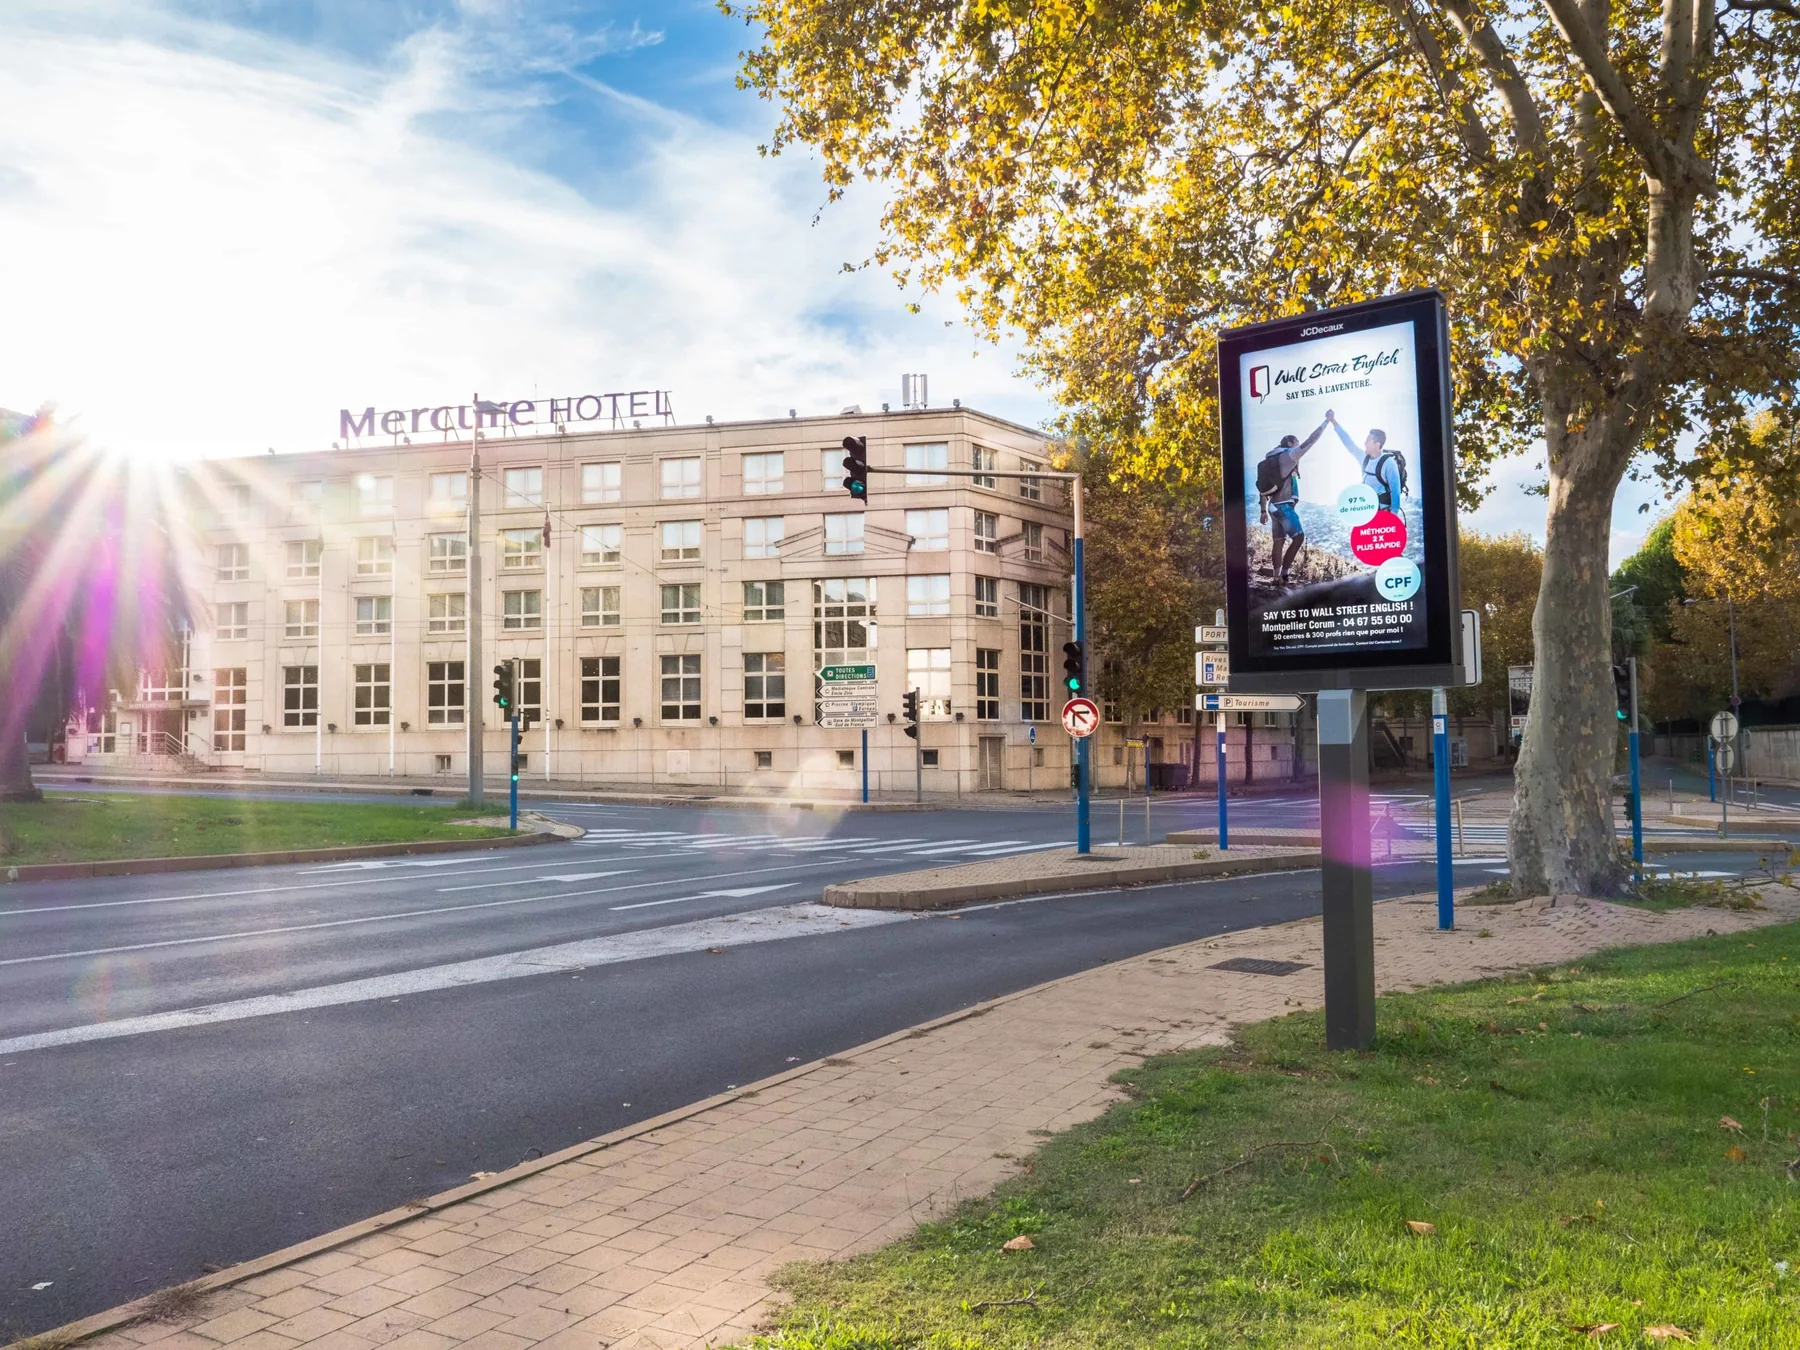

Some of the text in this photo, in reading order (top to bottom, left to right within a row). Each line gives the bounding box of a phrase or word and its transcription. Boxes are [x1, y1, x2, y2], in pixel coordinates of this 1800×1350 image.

[1300, 323, 1344, 337] JCDecaux
[1274, 348, 1400, 385] Wall Street English
[1286, 378, 1373, 400] SAY YES. À L'AVENTURE.
[340, 390, 672, 438] Mercure HOTEL
[1350, 504, 1375, 512] réussite
[1360, 526, 1397, 536] MÉTHODE
[1374, 541, 1401, 550] RAPIDE
[1384, 576, 1412, 589] CPF
[1263, 611, 1279, 620] SAY
[1281, 609, 1297, 619] YES
[1298, 608, 1309, 618] TO
[1311, 607, 1334, 617] WALL
[1336, 604, 1368, 615] STREET
[1370, 602, 1408, 613] ENGLISH
[1262, 620, 1307, 632] Montpellier
[1309, 620, 1335, 629] Corum
[1343, 617, 1355, 627] 04
[1357, 616, 1369, 626] 67
[1371, 615, 1383, 625] 55
[1385, 615, 1398, 624] 60
[1400, 614, 1413, 623] 00
[1205, 630, 1227, 639] PORT
[1325, 630, 1342, 638] profs
[1369, 628, 1386, 636] pour
[1205, 655, 1227, 663] Rives
[1234, 697, 1270, 707] Tourisme
